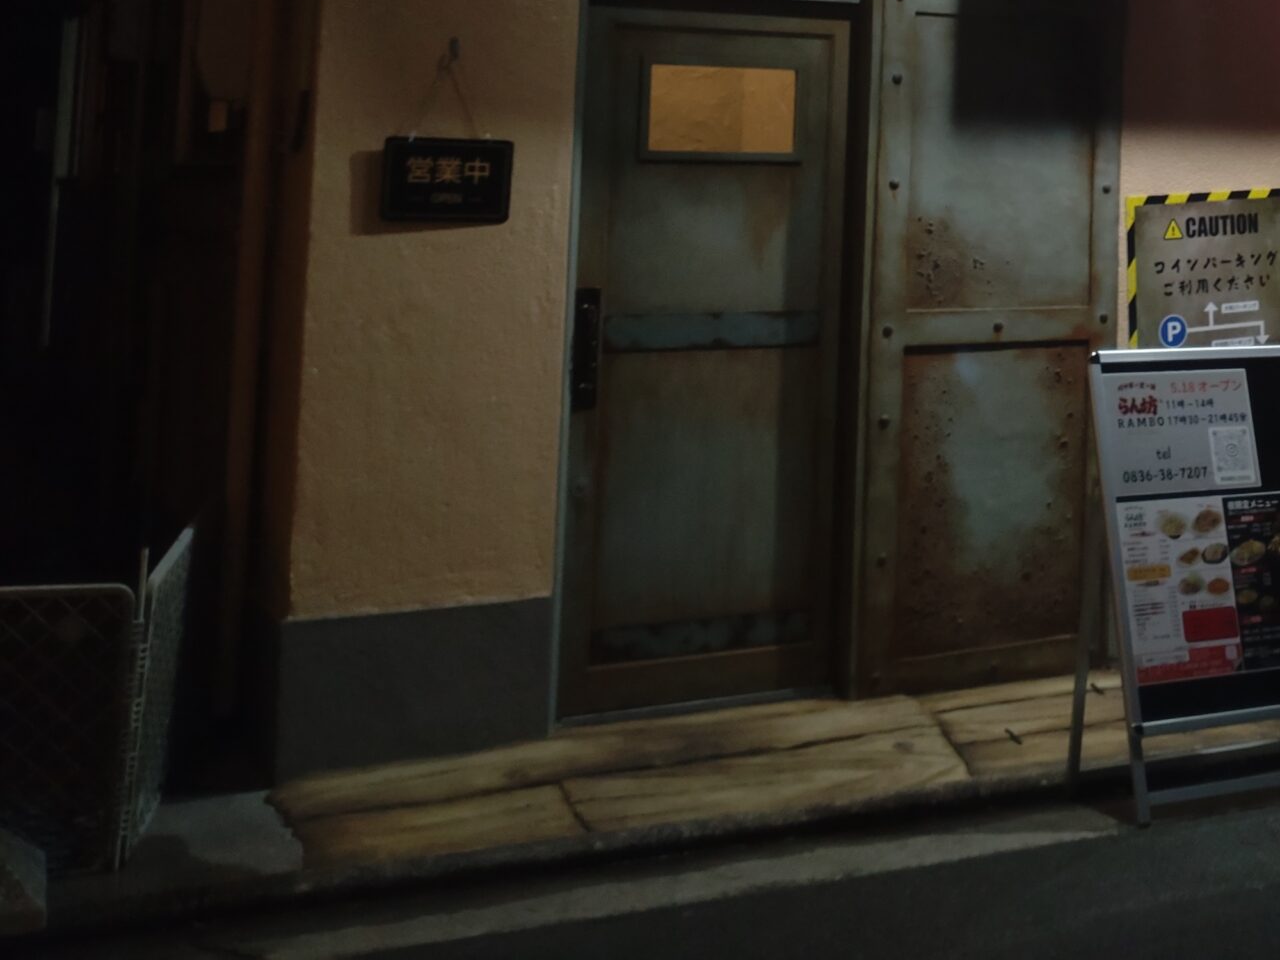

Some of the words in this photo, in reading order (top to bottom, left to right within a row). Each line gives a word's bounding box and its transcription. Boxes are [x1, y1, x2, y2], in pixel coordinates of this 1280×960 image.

[406, 157, 490, 184] 営業中
[1185, 213, 1259, 239] CAUTION
[1154, 251, 1278, 275] コインパーキング
[1163, 274, 1271, 297] ご利用ください
[1167, 321, 1181, 342] P
[1117, 416, 1165, 428] RAMBO
[1156, 447, 1171, 461] tel
[1123, 466, 1208, 484] 0836-38-7207
